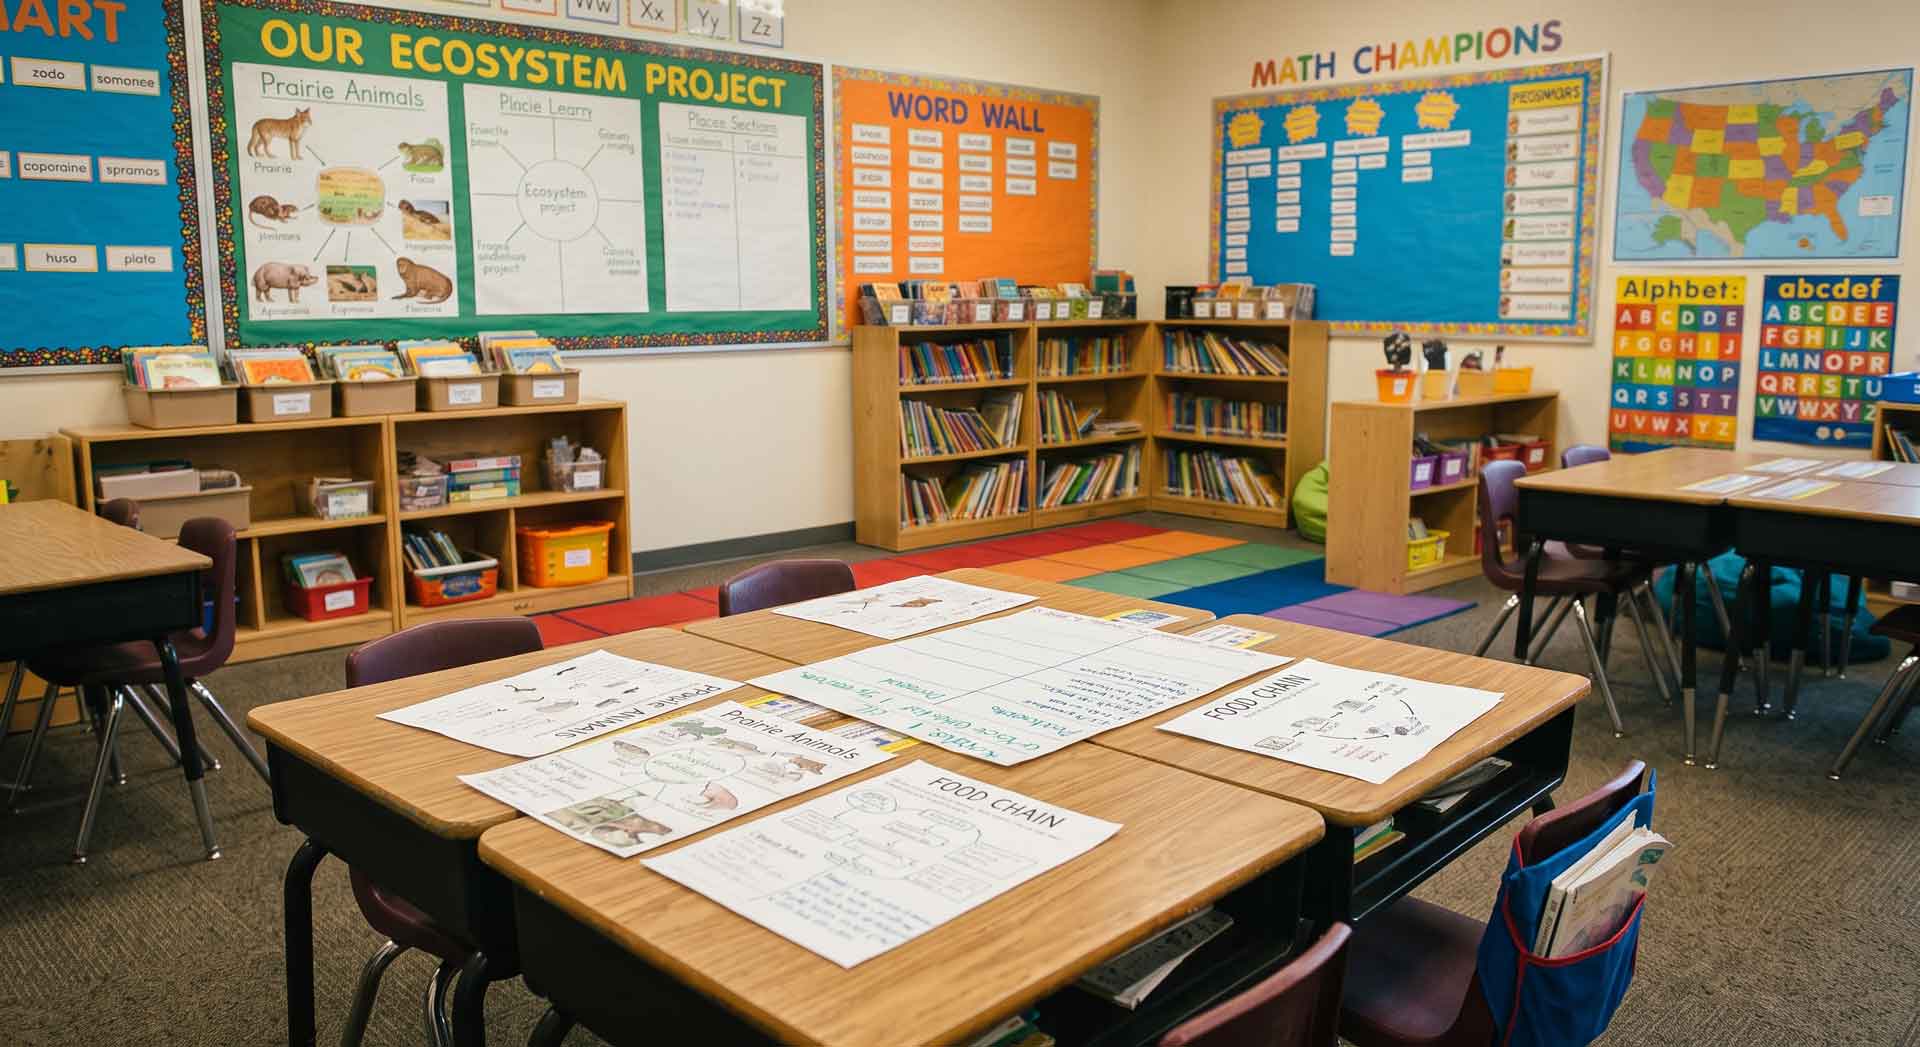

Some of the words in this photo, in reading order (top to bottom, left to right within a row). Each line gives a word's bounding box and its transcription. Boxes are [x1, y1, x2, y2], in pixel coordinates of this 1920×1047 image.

[640, 0, 664, 21] Xx
[698, 8, 719, 34] Yy
[0, 0, 126, 43] ART
[751, 17, 771, 36] Zz
[260, 19, 364, 65] OUR
[390, 33, 627, 93] ECOSYSTEM
[645, 63, 787, 108] PROJECT
[1251, 51, 1335, 88] MATH
[1353, 20, 1563, 74] CHAMPIONS
[261, 72, 335, 100] Prairie
[345, 80, 424, 107] Animals
[888, 91, 968, 125] WORD
[982, 102, 1045, 132] WALL
[525, 184, 587, 201] Ecosystem
[540, 203, 576, 216] project
[1778, 278, 1883, 299] abcdef
[1620, 310, 1632, 323] A
[1641, 310, 1651, 324] B
[1660, 310, 1672, 325] C
[1682, 311, 1694, 325] D
[1703, 311, 1716, 325] D
[1726, 312, 1736, 326] E
[1767, 305, 1781, 320] A
[1809, 305, 1823, 321] C
[1830, 305, 1845, 321] D
[1854, 306, 1864, 322] E
[1876, 306, 1888, 322] E
[1619, 336, 1628, 349] F
[1637, 337, 1651, 351] G
[1659, 338, 1672, 352] G
[1680, 339, 1693, 352] H
[1705, 339, 1711, 352] I
[1725, 340, 1734, 354] J
[1766, 328, 1777, 344] F
[1783, 328, 1798, 345] G
[1805, 330, 1821, 344] H
[1831, 329, 1838, 345] I
[1851, 330, 1861, 347] J
[1870, 332, 1886, 348] K
[1618, 363, 1629, 376] K
[1638, 363, 1648, 378] L
[1656, 365, 1671, 378] M
[1678, 366, 1692, 380] N
[1699, 367, 1714, 381] O
[1722, 367, 1734, 381] P
[1764, 352, 1774, 368] L
[1780, 352, 1798, 368] M
[1804, 354, 1820, 369] N
[1826, 354, 1843, 370] O
[1850, 355, 1864, 371] P
[1871, 356, 1884, 372] R
[1761, 375, 1777, 392] Q
[1782, 376, 1795, 392] R
[1802, 378, 1816, 392] R
[1824, 379, 1837, 394] S
[1847, 379, 1860, 395] T
[1866, 380, 1882, 396] U
[1616, 389, 1628, 403] Q
[1636, 390, 1647, 403] R
[1658, 391, 1667, 405] S
[1679, 392, 1688, 406] S
[1700, 394, 1710, 408] T
[1721, 395, 1731, 409] T
[1760, 398, 1774, 413] V
[1778, 400, 1797, 414] W
[1799, 400, 1819, 416] W
[1822, 402, 1837, 418] X
[1843, 403, 1858, 419] Y
[1615, 414, 1627, 428] U
[1634, 416, 1645, 428] V
[1653, 418, 1669, 431] W
[1676, 418, 1688, 432] X
[1699, 421, 1709, 433] Y
[1718, 422, 1728, 436] Z
[1203, 697, 1258, 720] FOOD
[1252, 674, 1312, 699] CHAIN
[720, 709, 783, 736] Prairie
[784, 732, 860, 760] Animals
[928, 777, 988, 801] FOOD
[991, 799, 1066, 828] CHAIN
